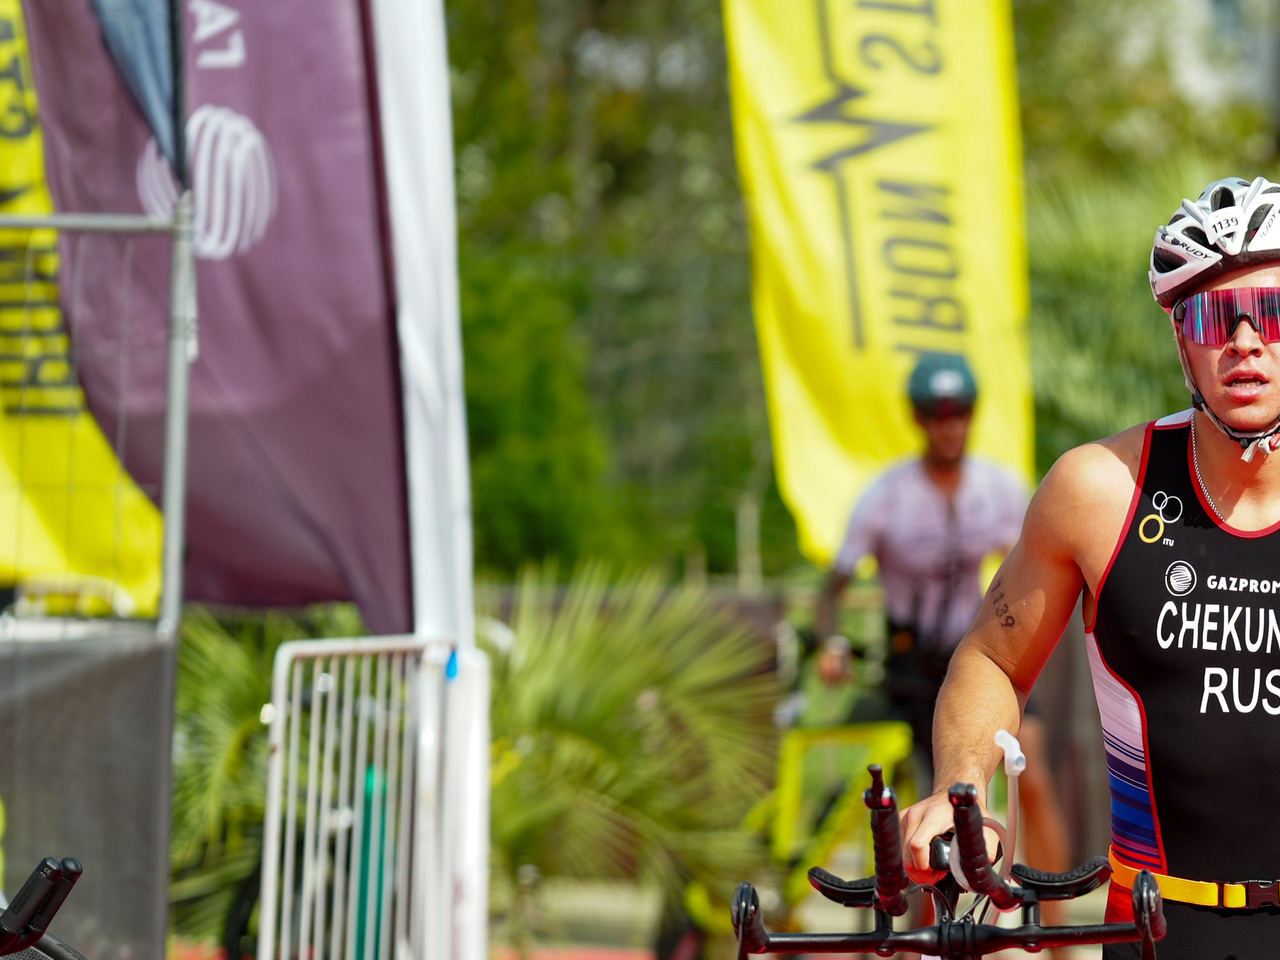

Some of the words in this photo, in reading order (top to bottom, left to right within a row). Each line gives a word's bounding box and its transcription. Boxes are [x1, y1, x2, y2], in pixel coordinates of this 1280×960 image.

[1212, 217, 1239, 234] 1139
[1179, 242, 1212, 259] RUDY
[991, 579, 1016, 628] 1139
